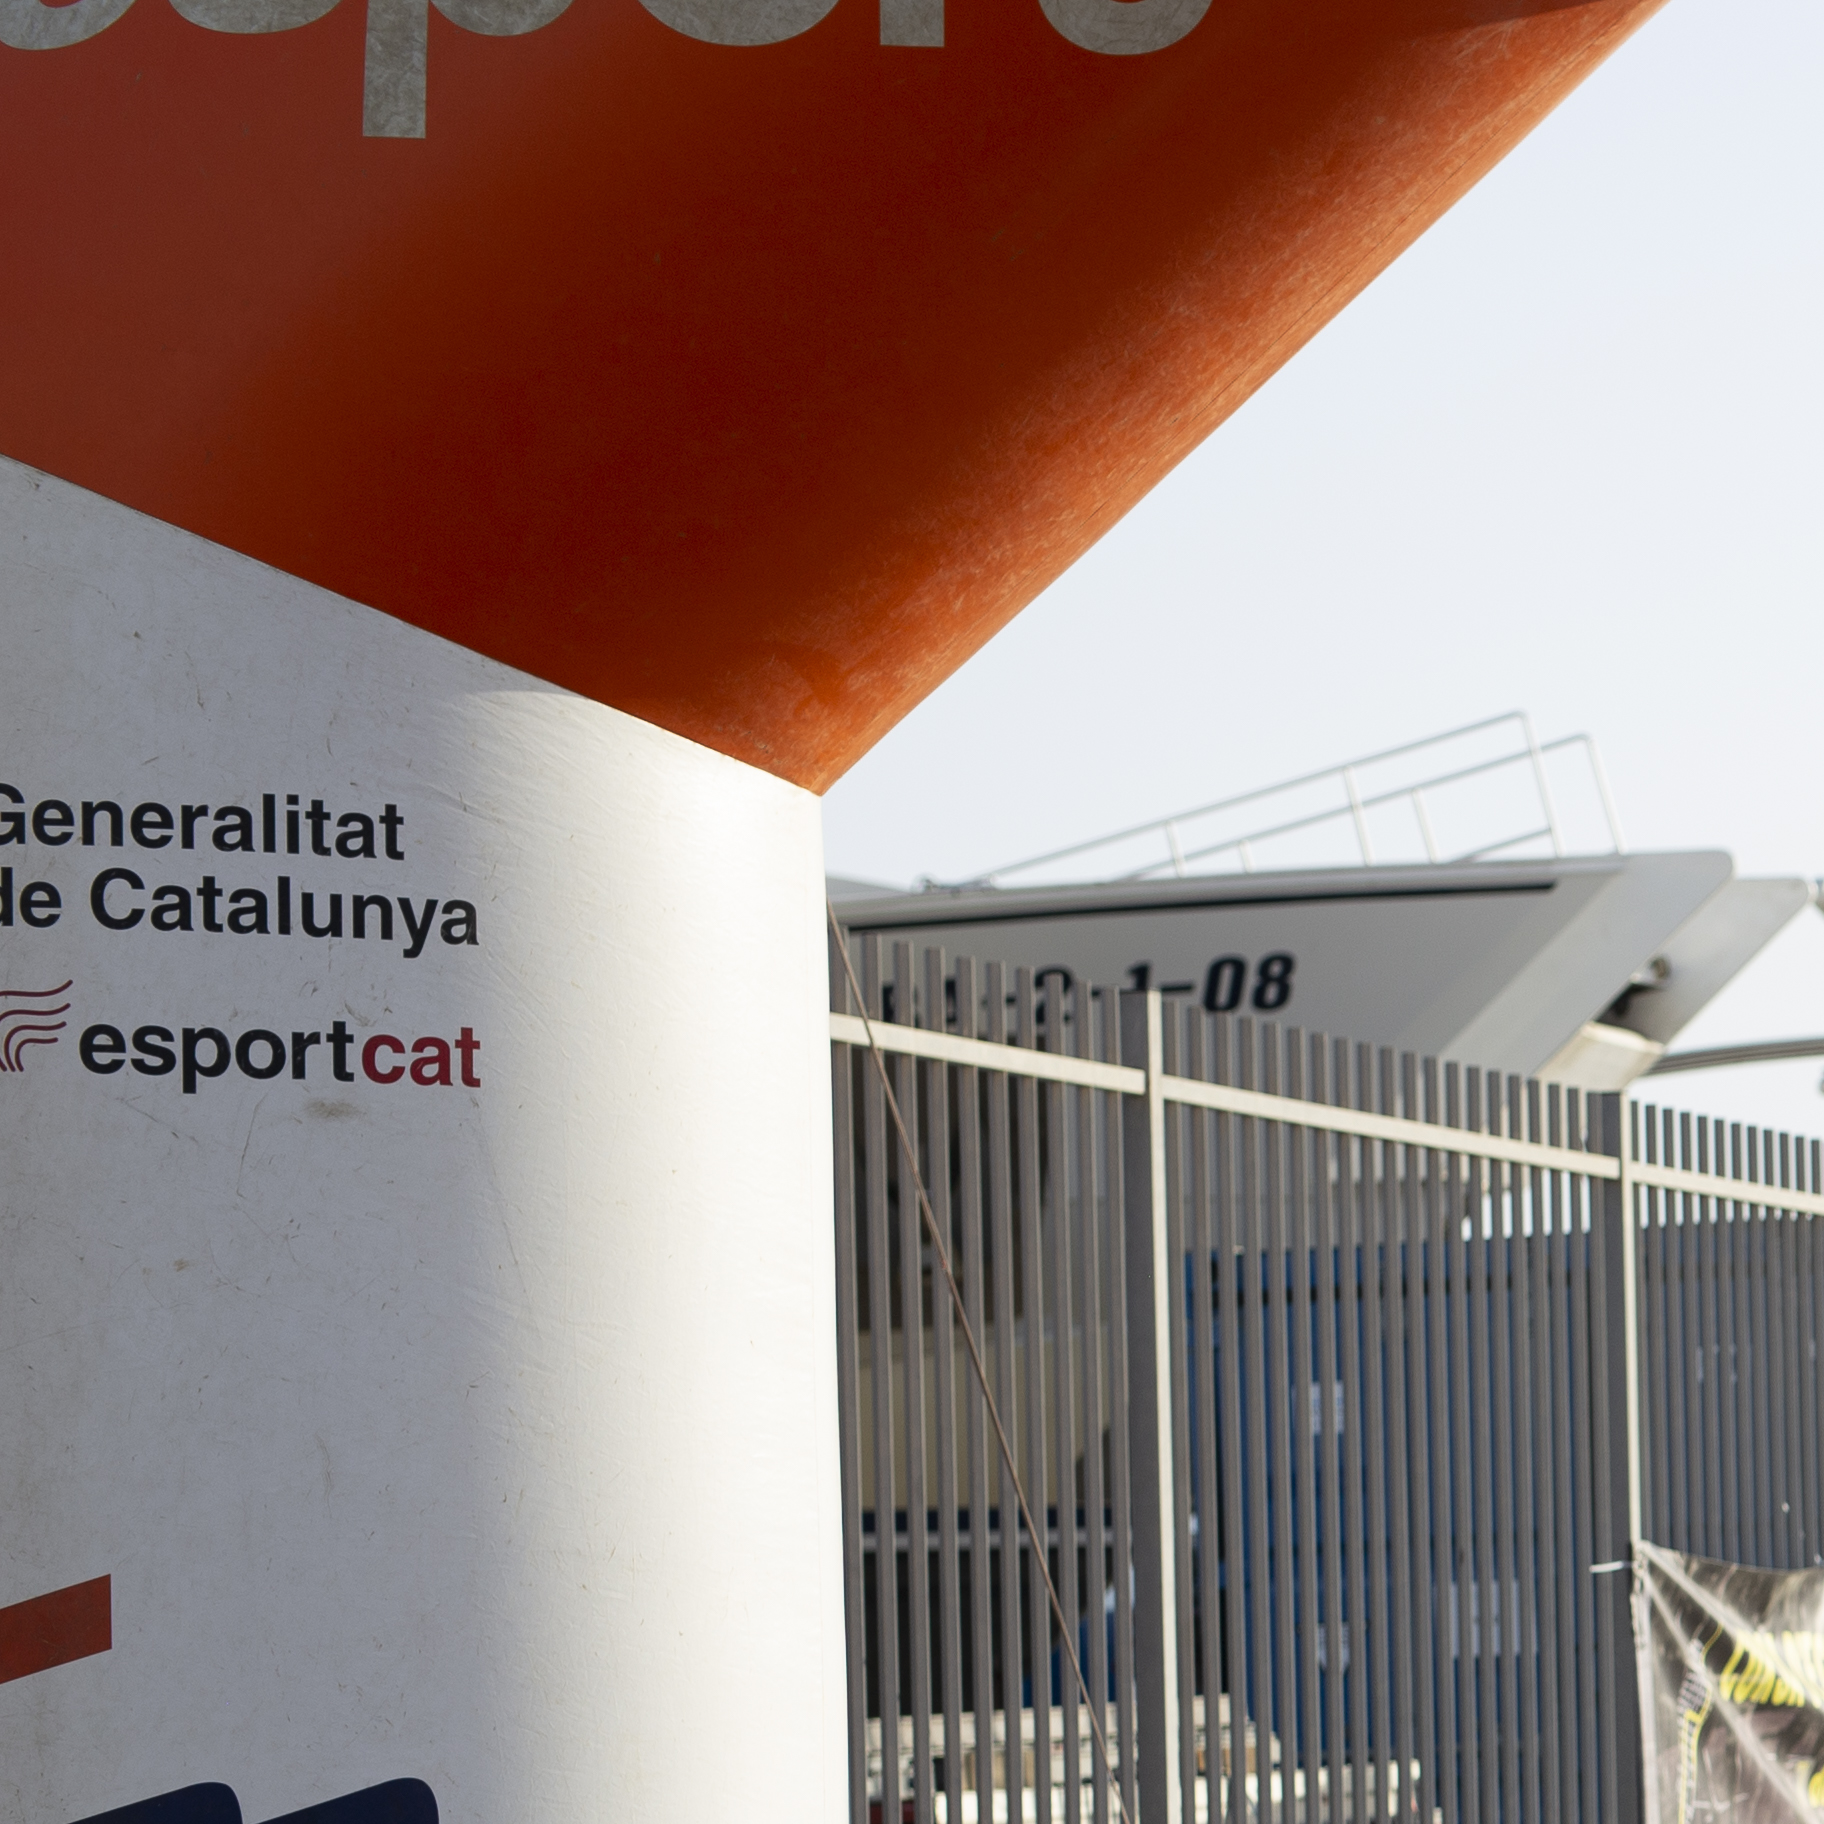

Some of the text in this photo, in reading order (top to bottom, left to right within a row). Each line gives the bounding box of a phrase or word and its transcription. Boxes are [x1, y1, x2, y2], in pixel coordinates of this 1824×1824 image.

[0, 867, 479, 958] e Catalunya
[79, 1021, 481, 1094] esportcat
